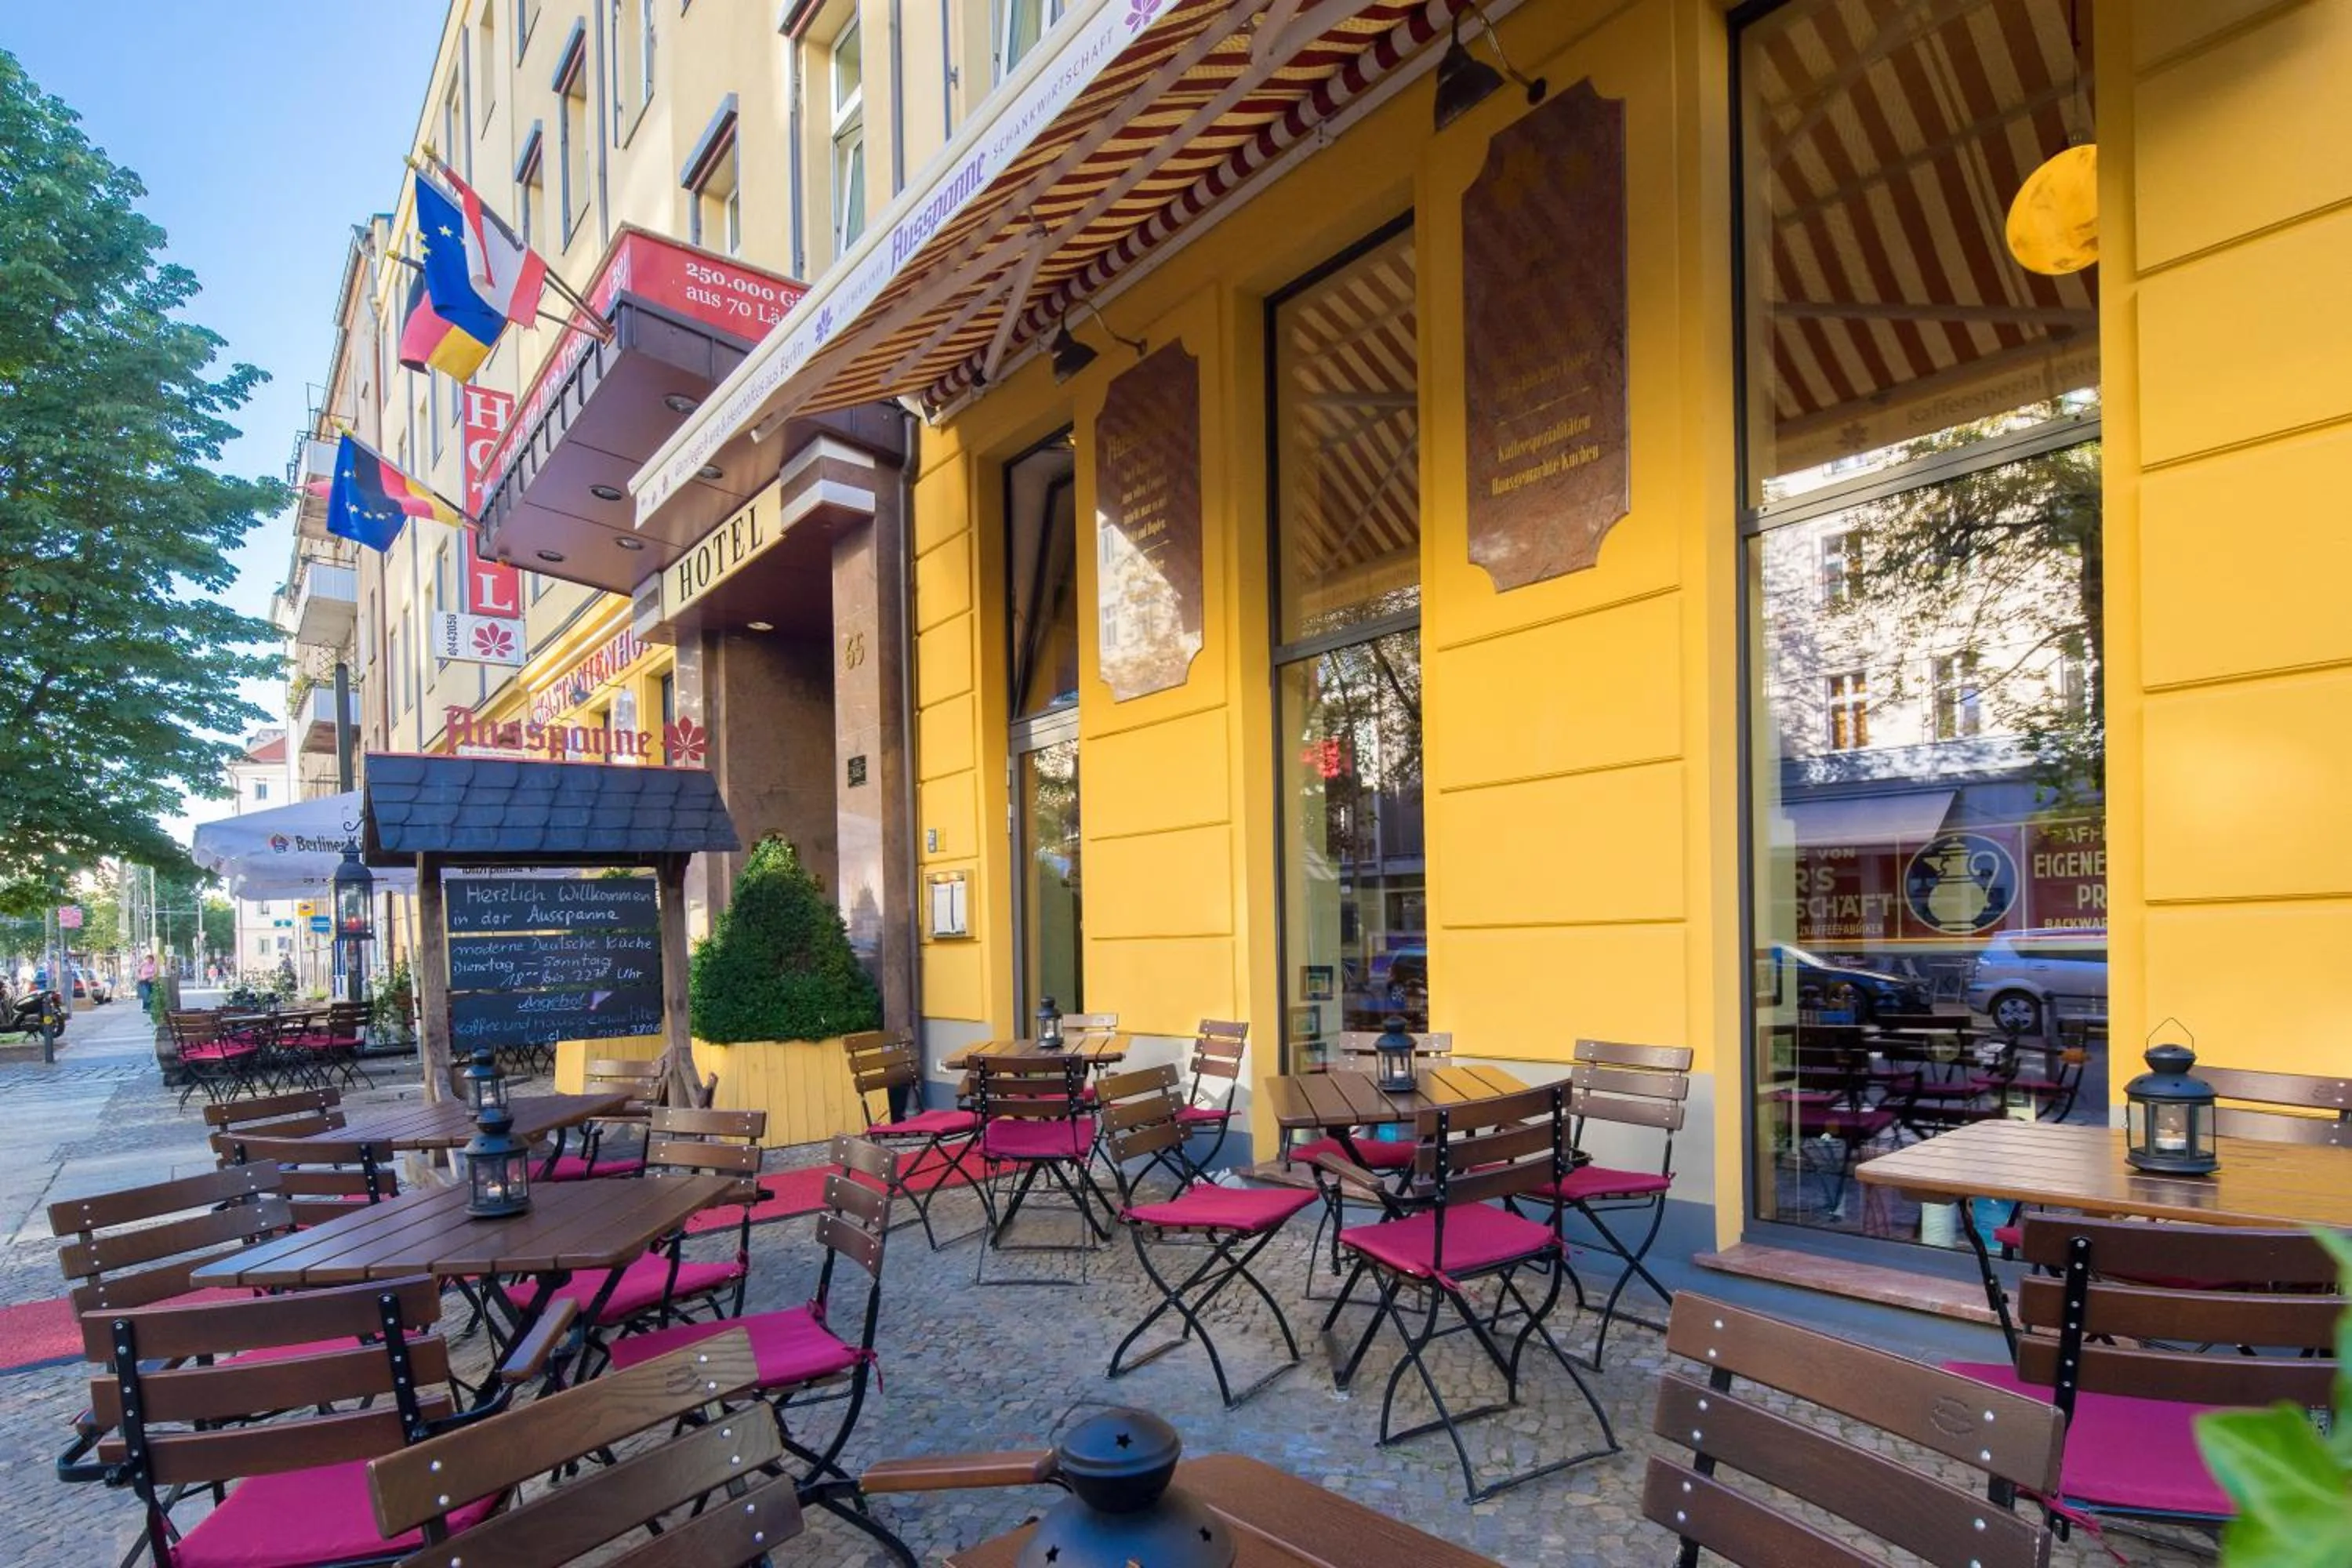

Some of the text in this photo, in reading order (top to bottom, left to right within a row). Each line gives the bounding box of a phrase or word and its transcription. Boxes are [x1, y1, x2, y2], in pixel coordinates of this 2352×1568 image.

[993, 27, 1114, 159] SCHANKWIRTSCHAFT
[891, 152, 985, 277] Ausspanne
[686, 263, 775, 302] 250.000
[686, 285, 783, 325] aus 70 Lä
[678, 504, 764, 602] HOTEL
[445, 705, 653, 758] Ausspanne
[295, 834, 344, 852] Berliner
[1817, 848, 1856, 861] VON
[2034, 851, 2106, 879] EIGENE
[466, 882, 652, 902] Herzlich Willkommen
[453, 904, 620, 925] in der Ausspanne
[452, 942, 525, 955] moderne
[543, 954, 612, 969] Sonntag
[617, 966, 644, 979] Uhr
[517, 993, 587, 1010] Angebot
